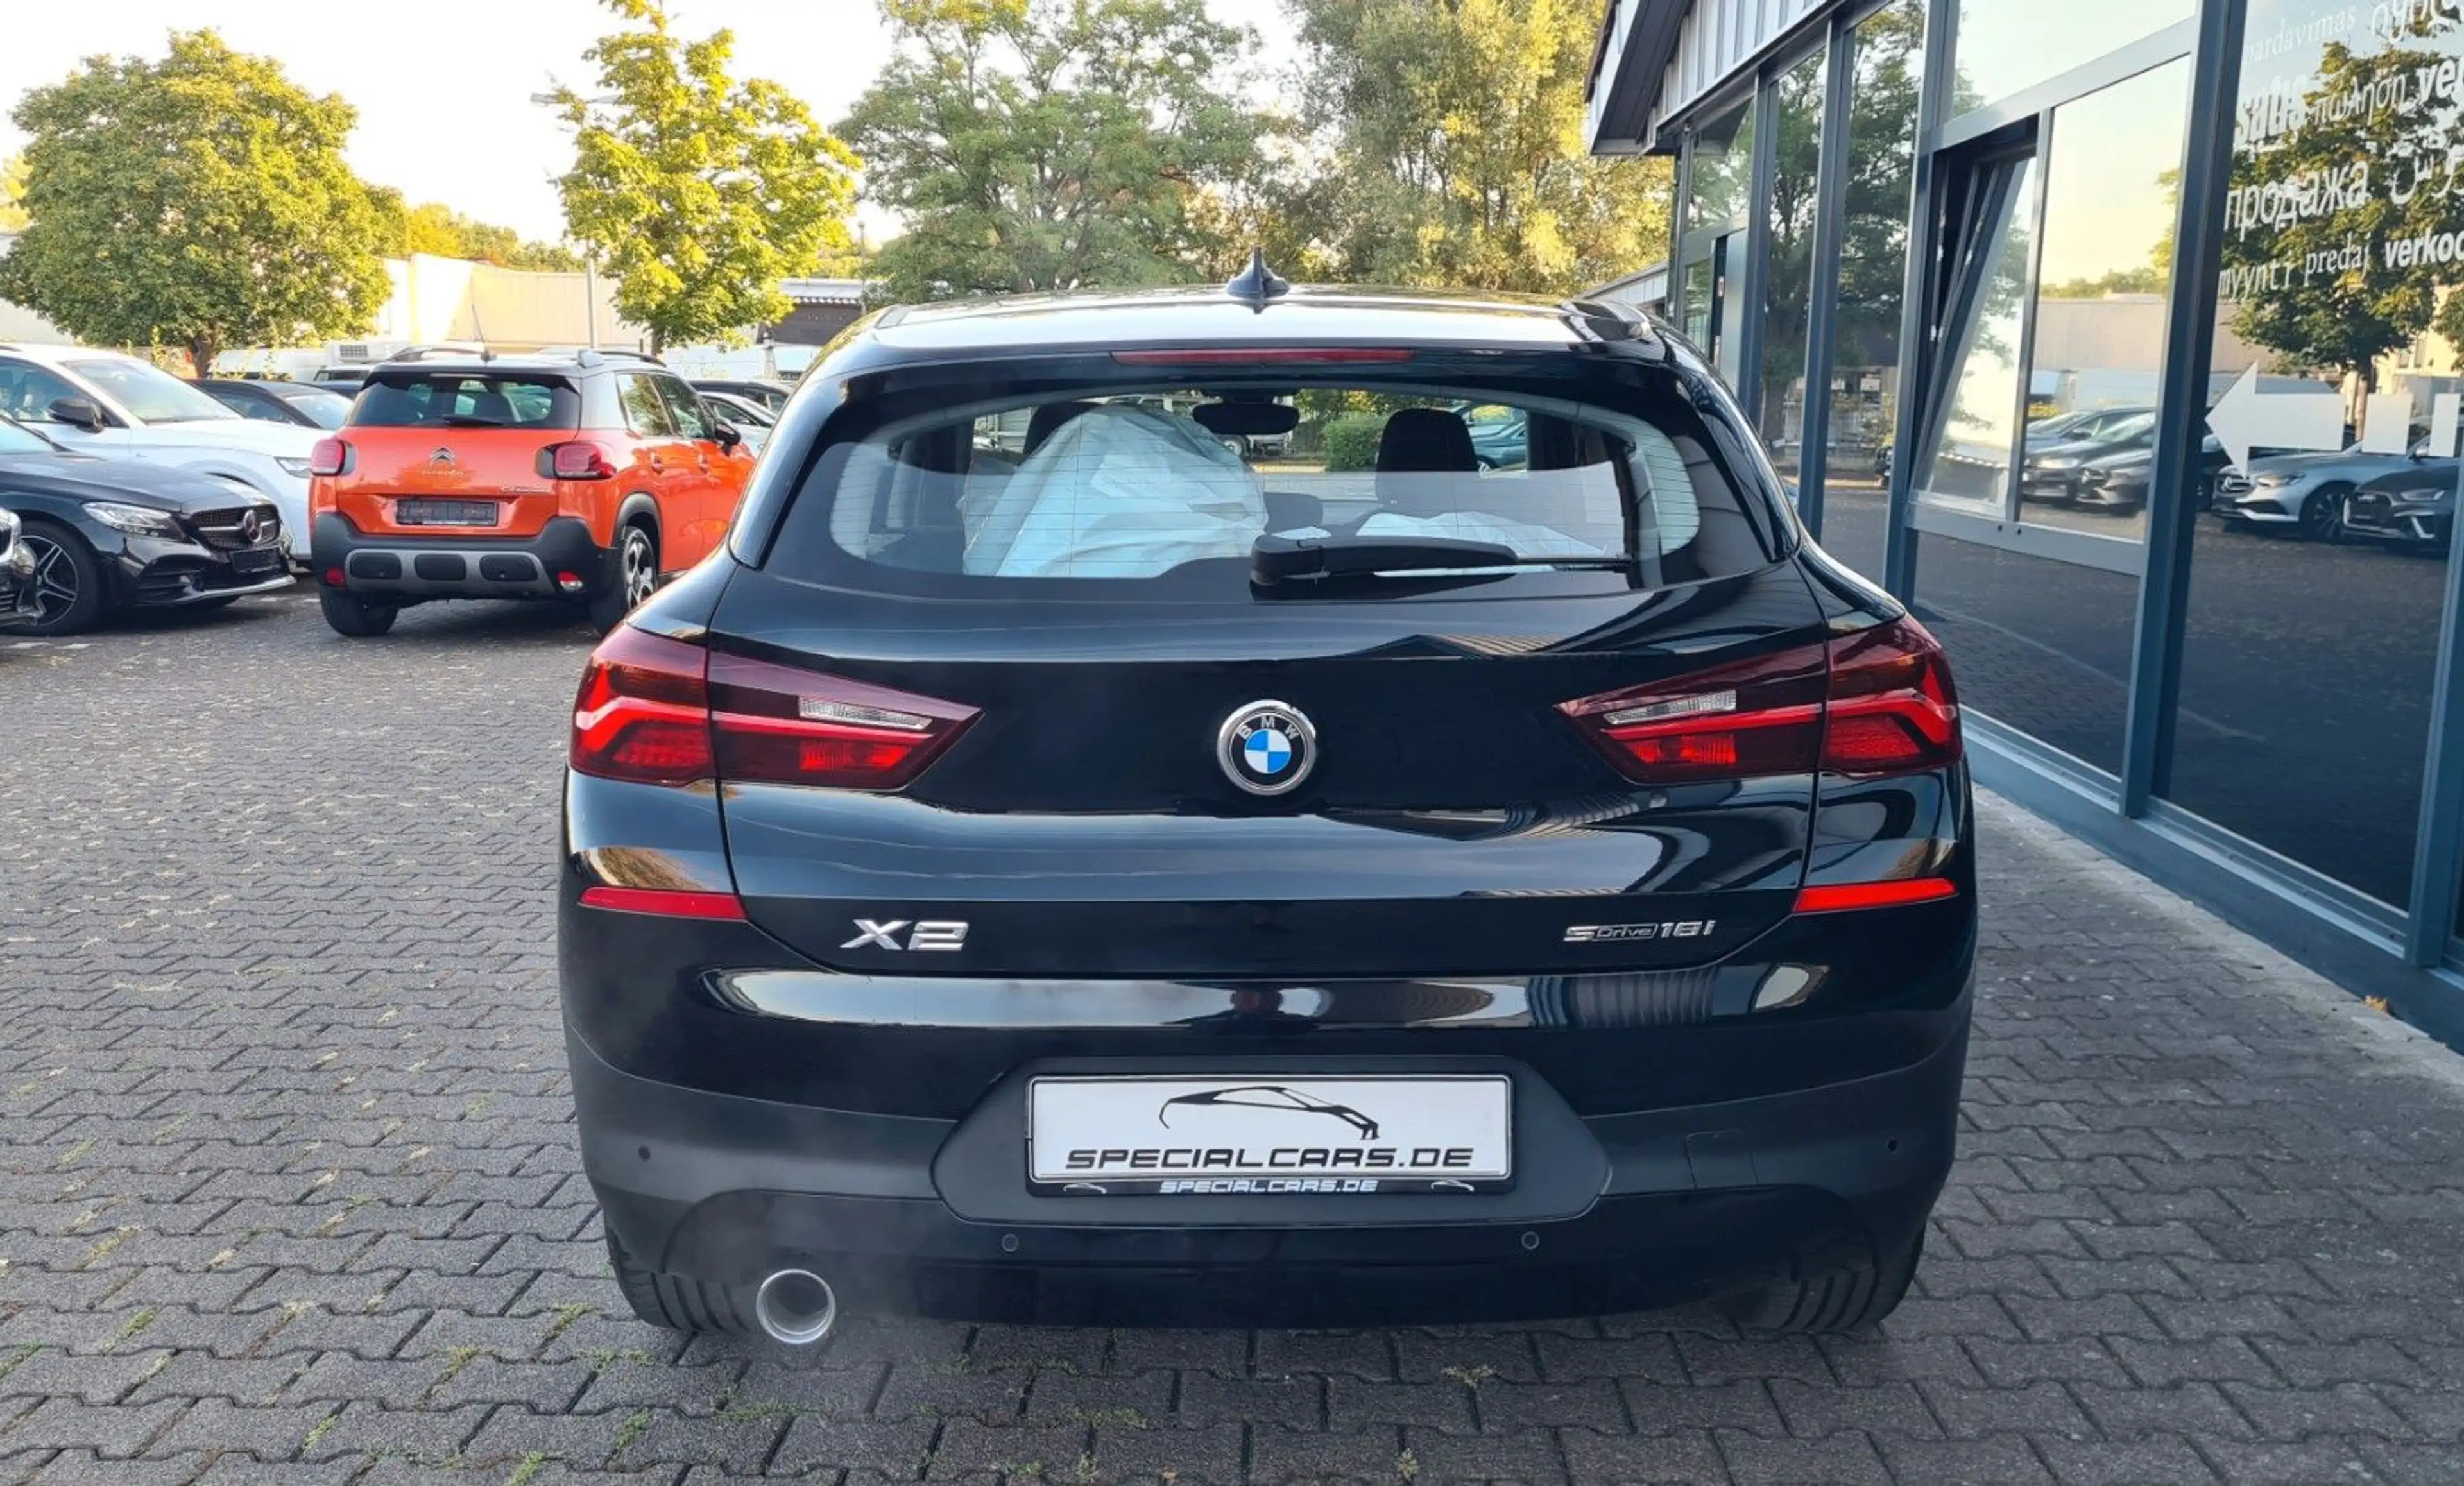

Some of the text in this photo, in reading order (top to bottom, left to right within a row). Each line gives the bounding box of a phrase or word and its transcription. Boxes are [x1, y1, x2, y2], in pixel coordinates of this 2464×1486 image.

[2224, 161, 2372, 242] продажа
[2303, 230, 2371, 287] predaj
[1237, 715, 1299, 740] BMW
[839, 919, 969, 951] X2
[1066, 1147, 1473, 1170] SPECIALCARS.DE
[1159, 1179, 1378, 1194] SPECIALCARS.DE
